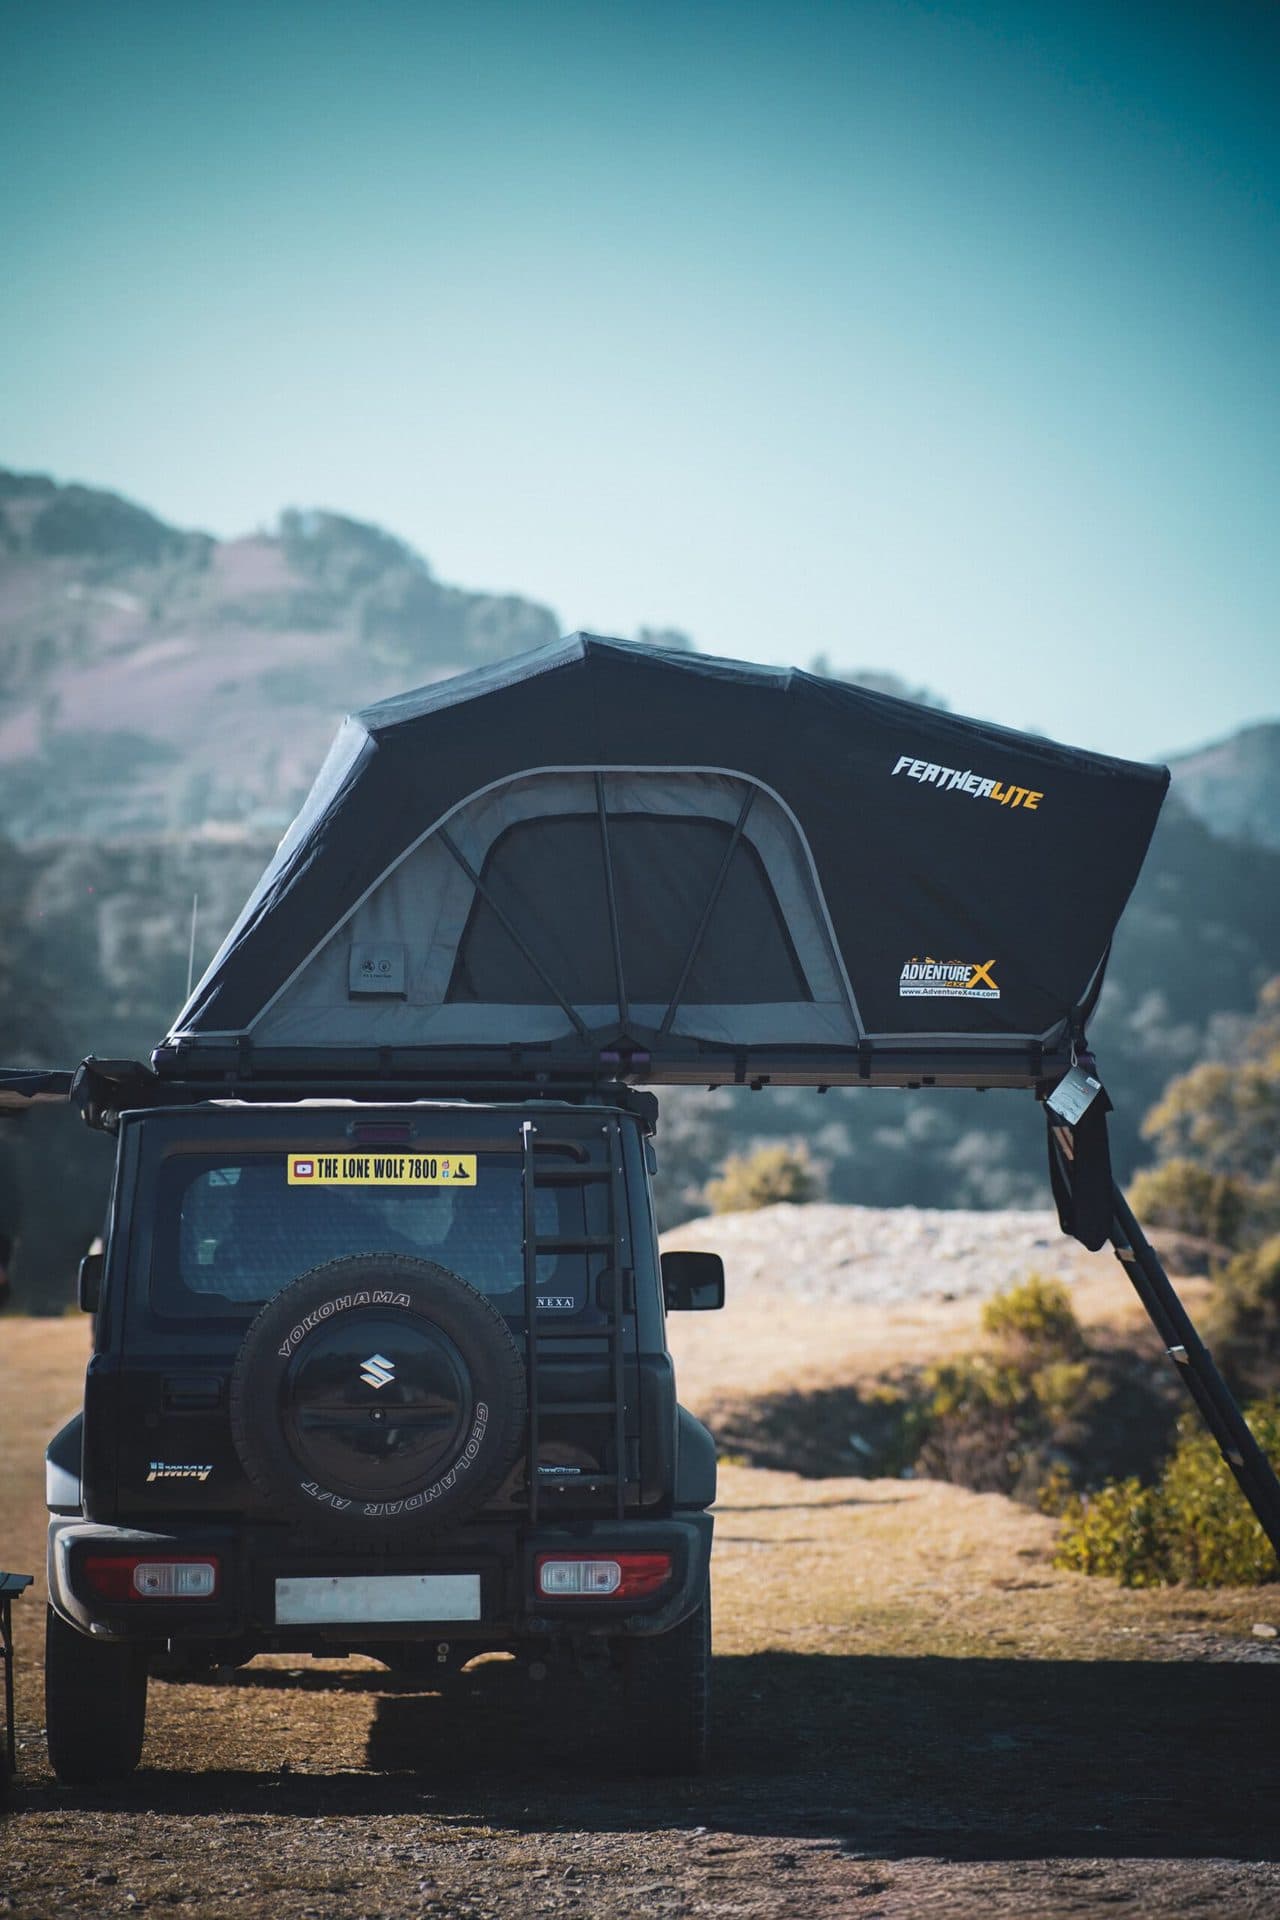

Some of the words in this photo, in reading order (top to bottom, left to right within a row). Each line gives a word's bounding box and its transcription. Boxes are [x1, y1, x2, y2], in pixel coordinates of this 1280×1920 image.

[891, 756, 1044, 810] FEATHERLITE
[901, 988, 998, 997] www.AdventureX4x4.com
[317, 1158, 338, 1179] THE
[343, 1158, 370, 1179] LONE
[374, 1158, 405, 1179] WOLF
[408, 1158, 438, 1179] 7800
[537, 1298, 571, 1306] NEXA
[278, 1291, 411, 1358] YOKOHAMA
[363, 1402, 489, 1516] GEOLANDAR
[301, 1480, 352, 1511] A/T
